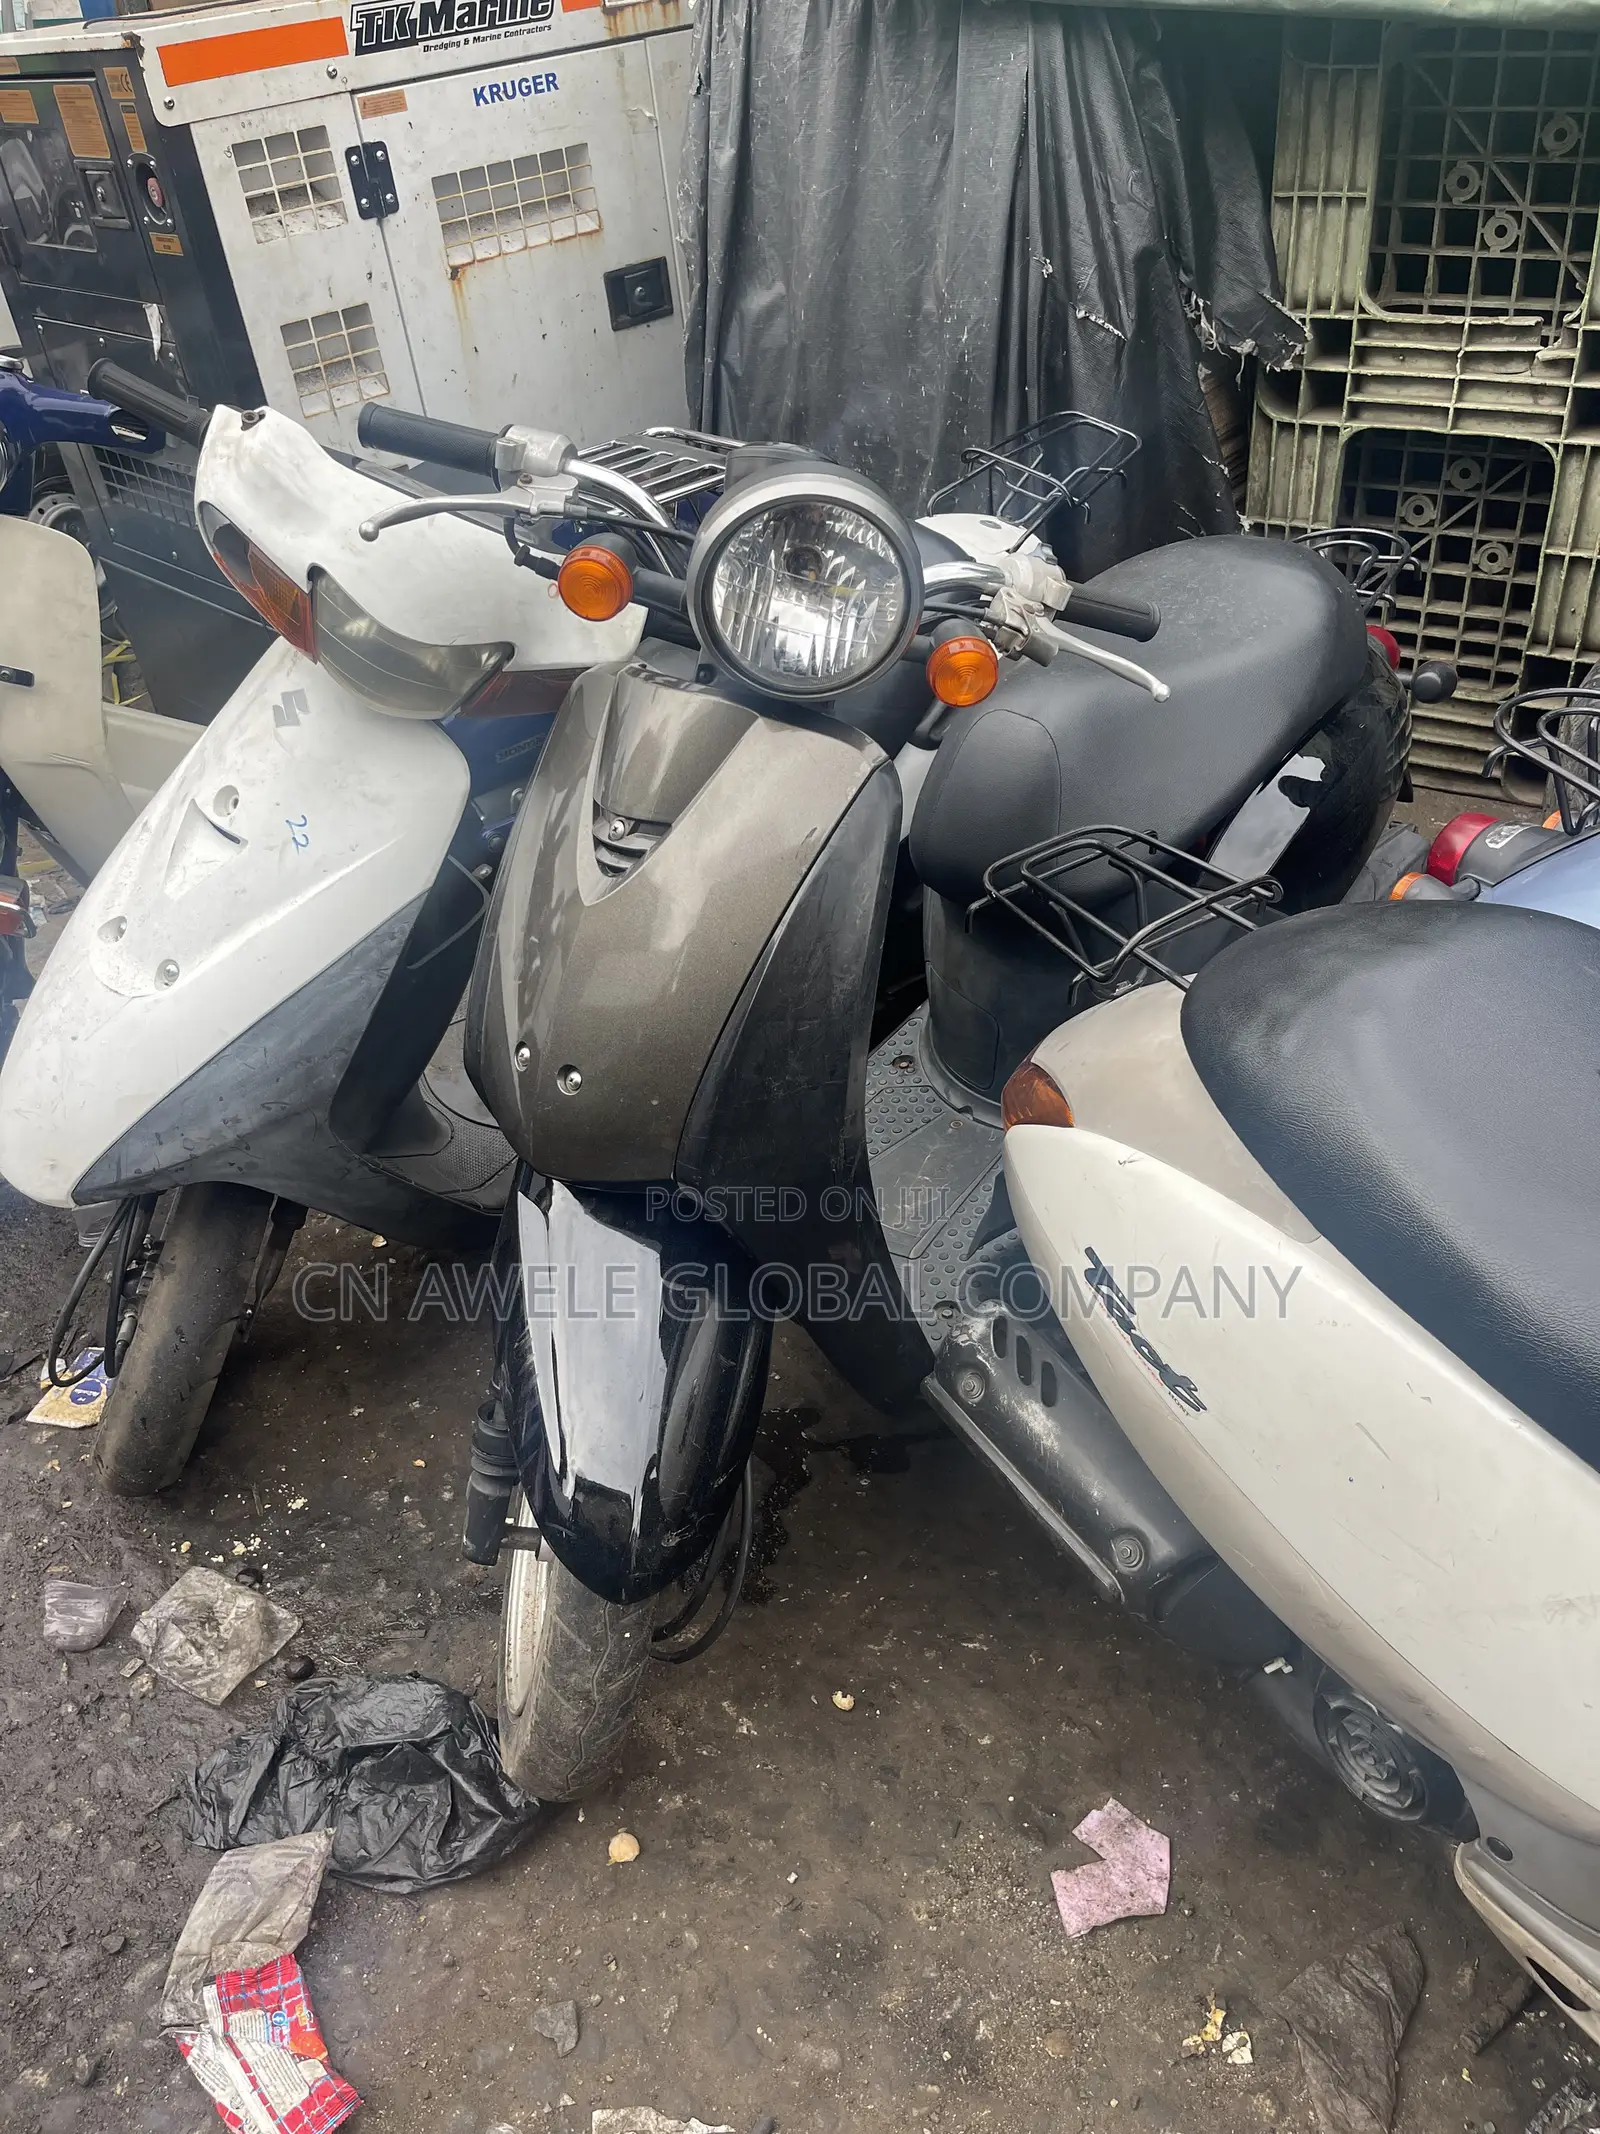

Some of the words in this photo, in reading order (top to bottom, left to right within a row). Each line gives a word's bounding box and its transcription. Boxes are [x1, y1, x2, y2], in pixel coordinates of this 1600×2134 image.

[423, 40, 461, 53] Dredging
[463, 37, 470, 46] &
[472, 33, 502, 44] Marine
[503, 24, 552, 38] Contractors
[472, 72, 560, 107] KRUGER
